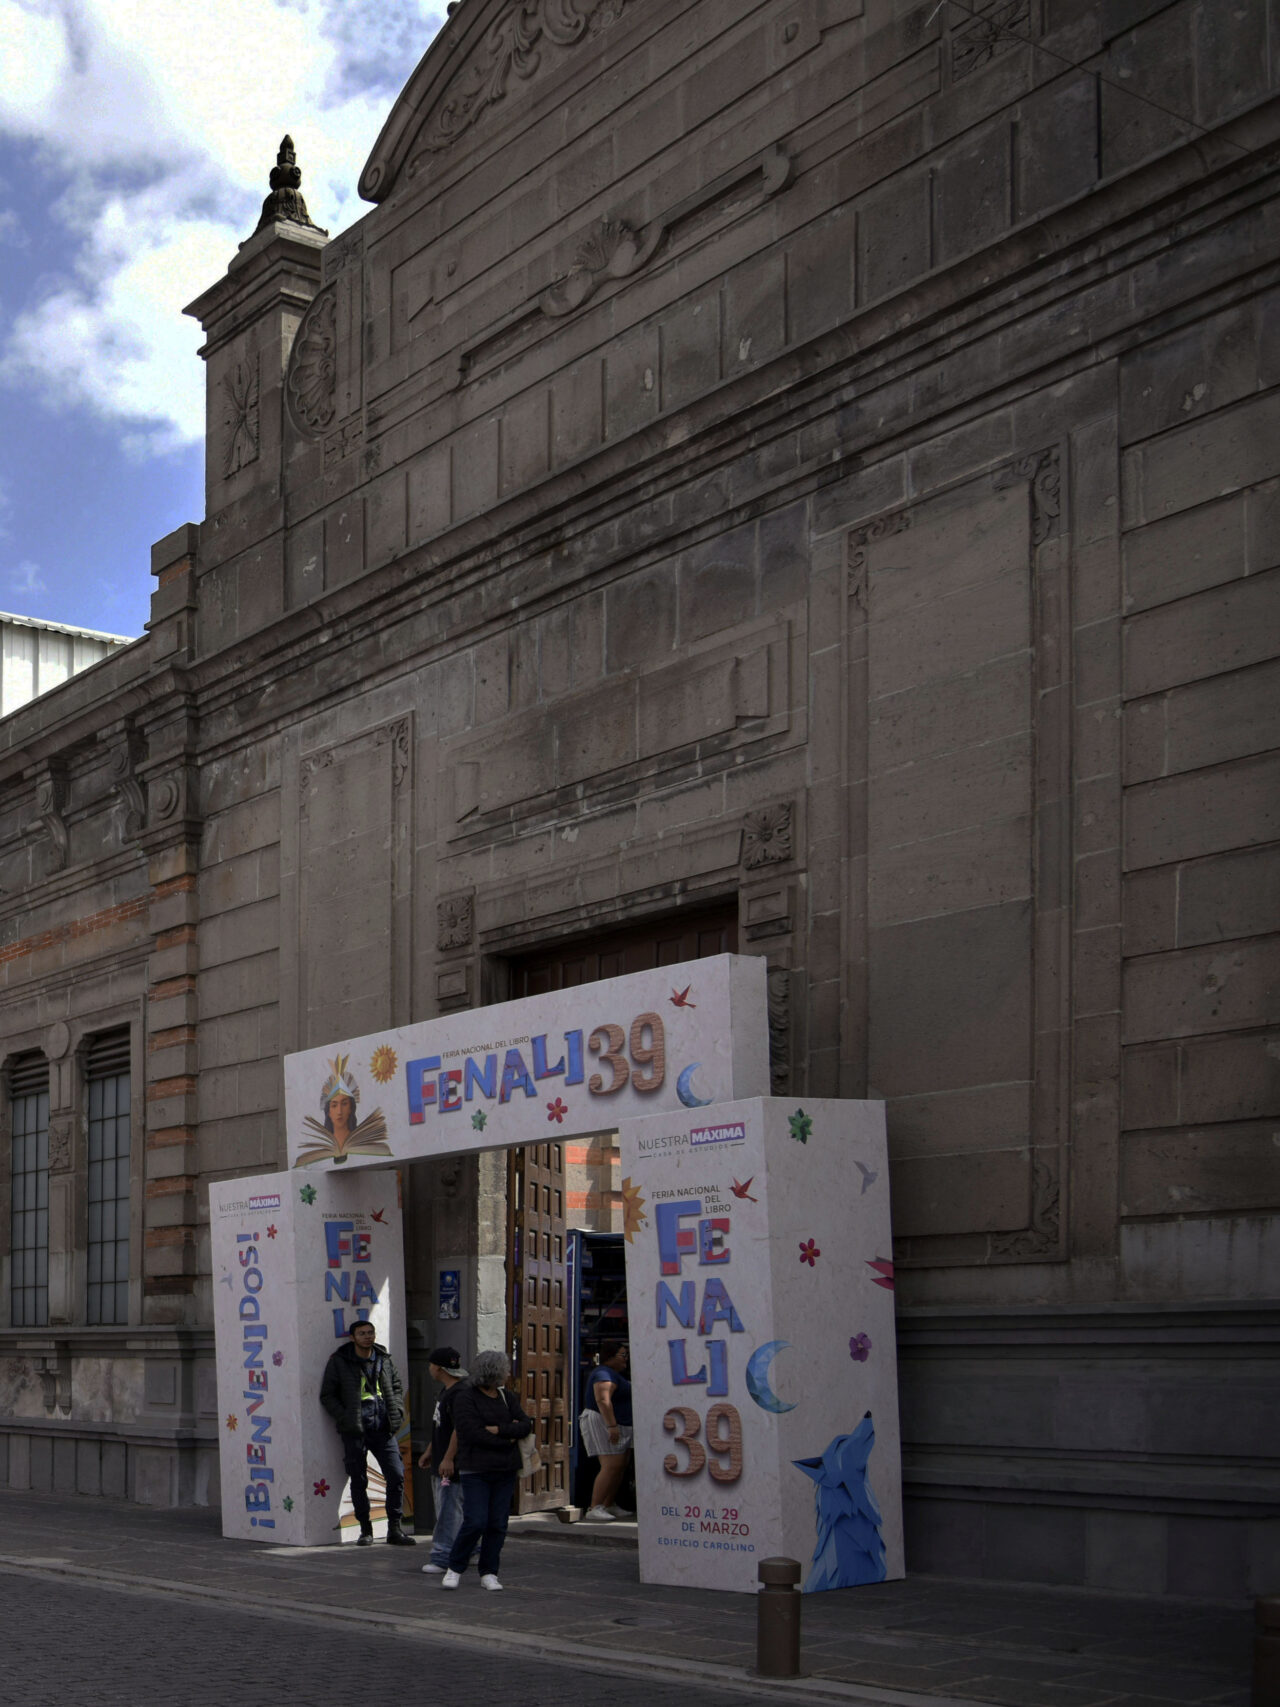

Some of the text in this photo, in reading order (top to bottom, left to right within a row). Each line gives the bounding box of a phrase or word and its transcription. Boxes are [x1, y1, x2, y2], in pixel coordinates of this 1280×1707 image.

[442, 1035, 530, 1059] FERIA NACIONAL DEL LIBRO
[406, 1012, 665, 1126] FENALI 39
[638, 1126, 743, 1151] NUESTRA MÁXIMA
[651, 1185, 721, 1199] FERIA NACIONAL
[704, 1195, 721, 1204] DEL
[705, 1203, 732, 1214] LIBRO
[324, 1221, 371, 1268] FE
[655, 1200, 731, 1276] FE
[325, 1269, 379, 1306] NA
[656, 1277, 745, 1336] NA
[237, 1232, 275, 1529] ¡BIENVENIDOS!
[667, 1338, 728, 1396] LI
[663, 1403, 743, 1484] 39
[661, 1506, 738, 1520] DEL 20 AL 29
[682, 1521, 750, 1536] DE MARZO
[658, 1537, 755, 1552] EDIFICIO CAROLINO
